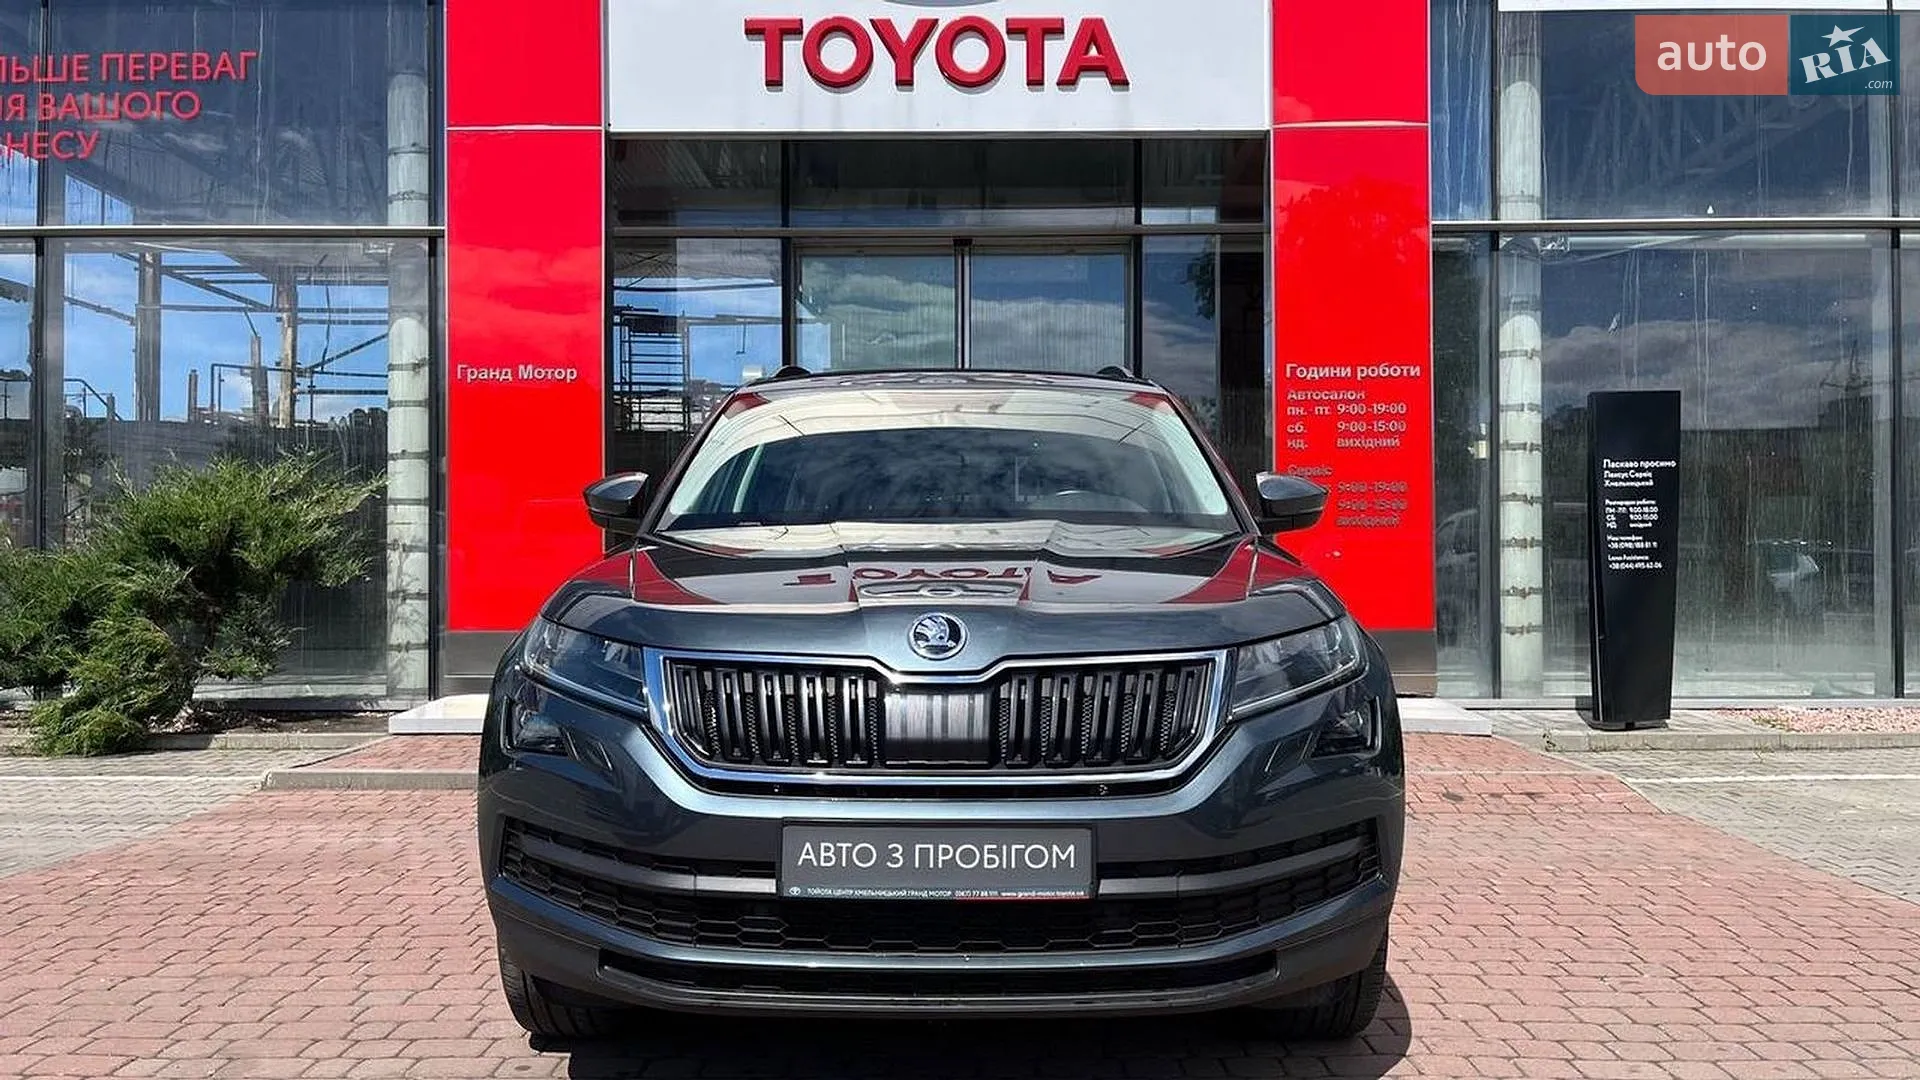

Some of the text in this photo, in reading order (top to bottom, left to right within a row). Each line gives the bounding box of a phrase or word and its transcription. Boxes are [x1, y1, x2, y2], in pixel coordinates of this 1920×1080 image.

[744, 15, 1130, 88] TOYOTA
[101, 51, 257, 82] ПЕРЕВАГ
[0, 90, 202, 121] Я ВАШОГО
[0, 130, 100, 161] НЕСУ
[457, 364, 578, 383] Гранд Мотор
[1285, 363, 1421, 380] Години роботи
[1287, 390, 1366, 400] Автосалон
[797, 842, 877, 868] АВТО
[914, 844, 1075, 869] ПРОБІГОМ
